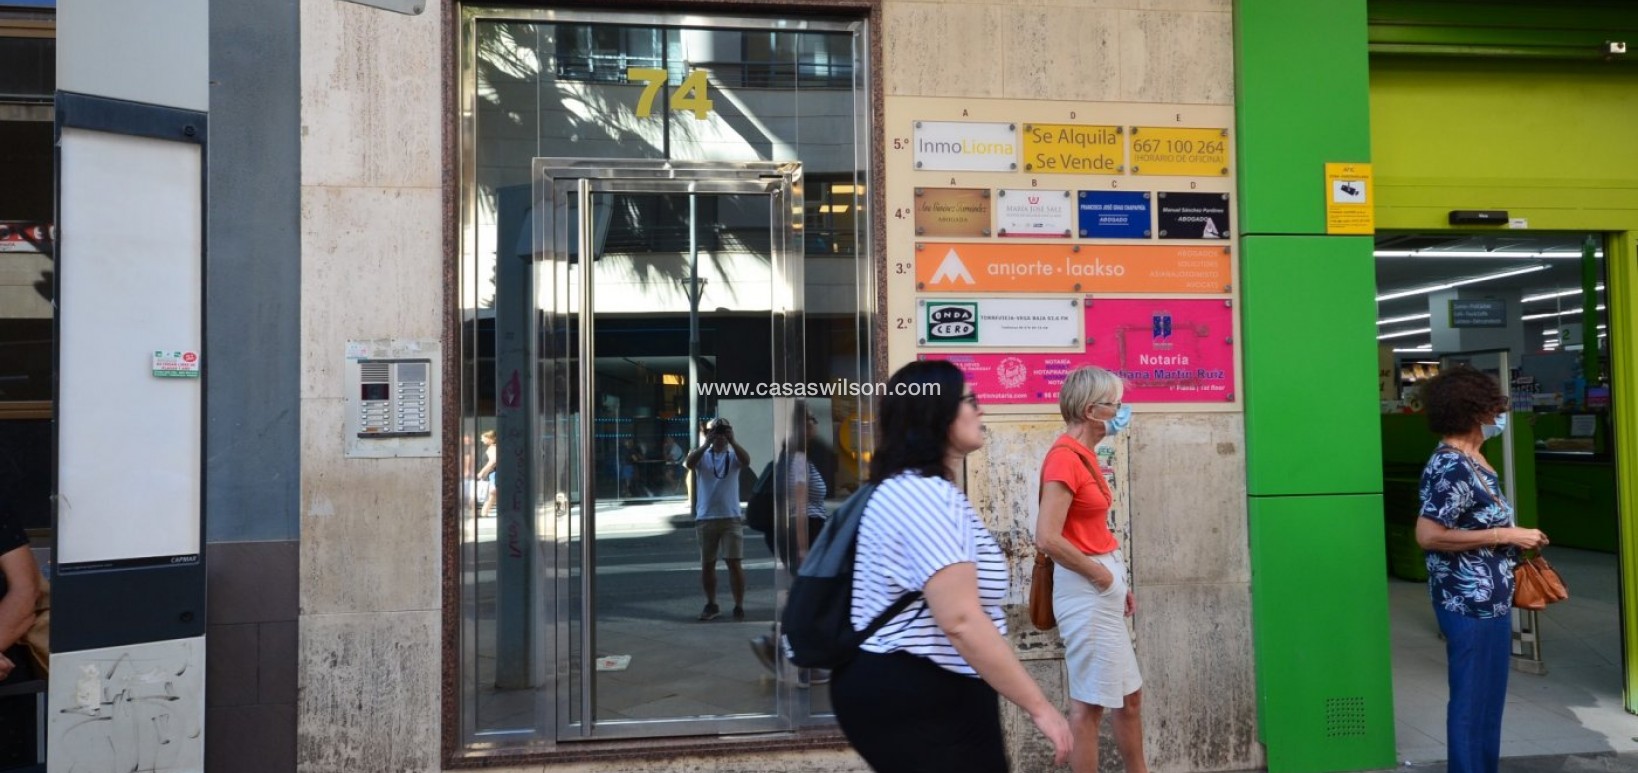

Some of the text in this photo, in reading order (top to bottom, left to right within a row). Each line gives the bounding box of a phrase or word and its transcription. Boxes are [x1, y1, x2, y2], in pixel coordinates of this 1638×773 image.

[627, 67, 714, 120] 74
[962, 109, 969, 117] A
[1070, 111, 1076, 119] D
[1176, 114, 1181, 122] E
[1033, 128, 1116, 147] Se Alquila
[919, 138, 1013, 155] InmoLiorna
[1134, 139, 1224, 154] 667 100 264
[1036, 153, 1114, 170] Se Vende
[1176, 155, 1187, 164] DE
[950, 178, 957, 186] A
[1112, 180, 1117, 188] C
[1191, 181, 1196, 189] D
[1066, 257, 1125, 277] laakso
[935, 311, 969, 320] ONDA
[937, 325, 969, 334] CERO
[1563, 329, 1570, 340] 2
[1197, 369, 1225, 379] Ruiz
[170, 556, 197, 564] CAPMAR
